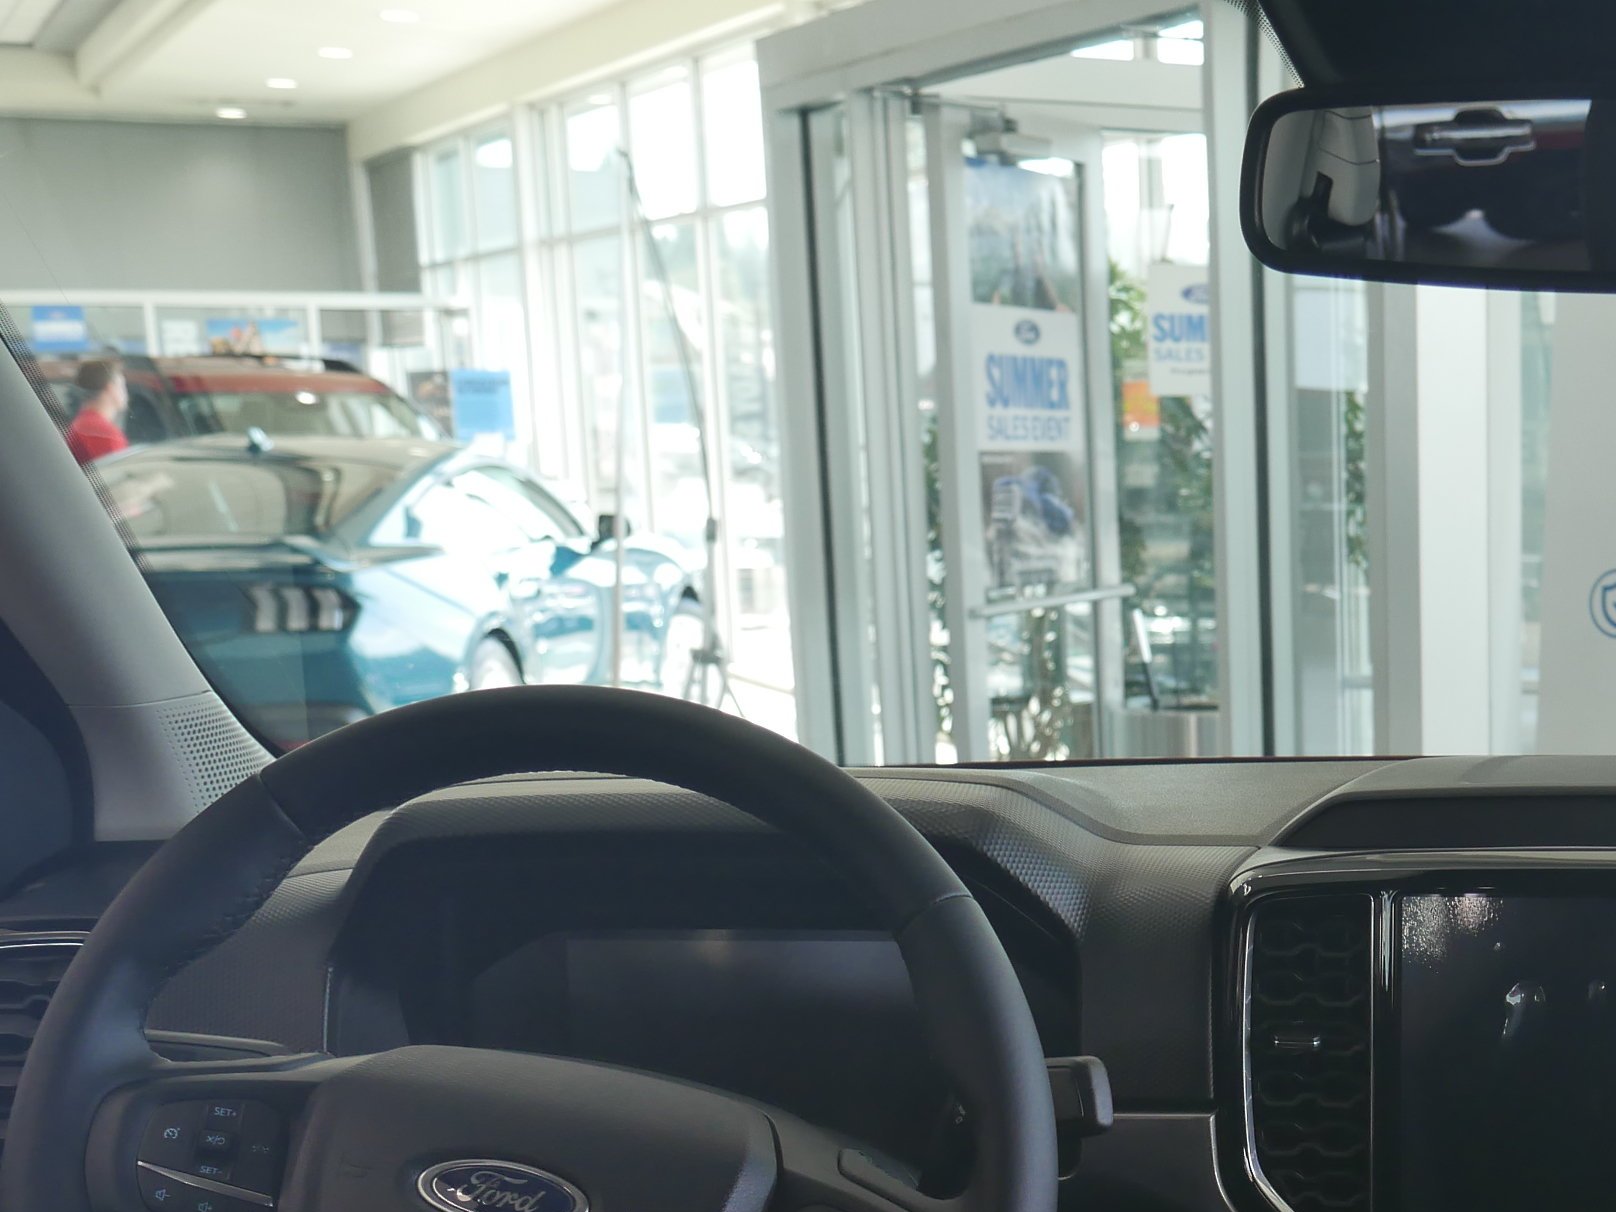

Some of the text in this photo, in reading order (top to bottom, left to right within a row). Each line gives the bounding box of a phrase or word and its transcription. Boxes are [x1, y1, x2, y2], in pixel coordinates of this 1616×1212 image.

[1152, 314, 1210, 343] SUM
[985, 352, 1070, 411] SUMMER
[987, 414, 1071, 442] SALES EVENT
